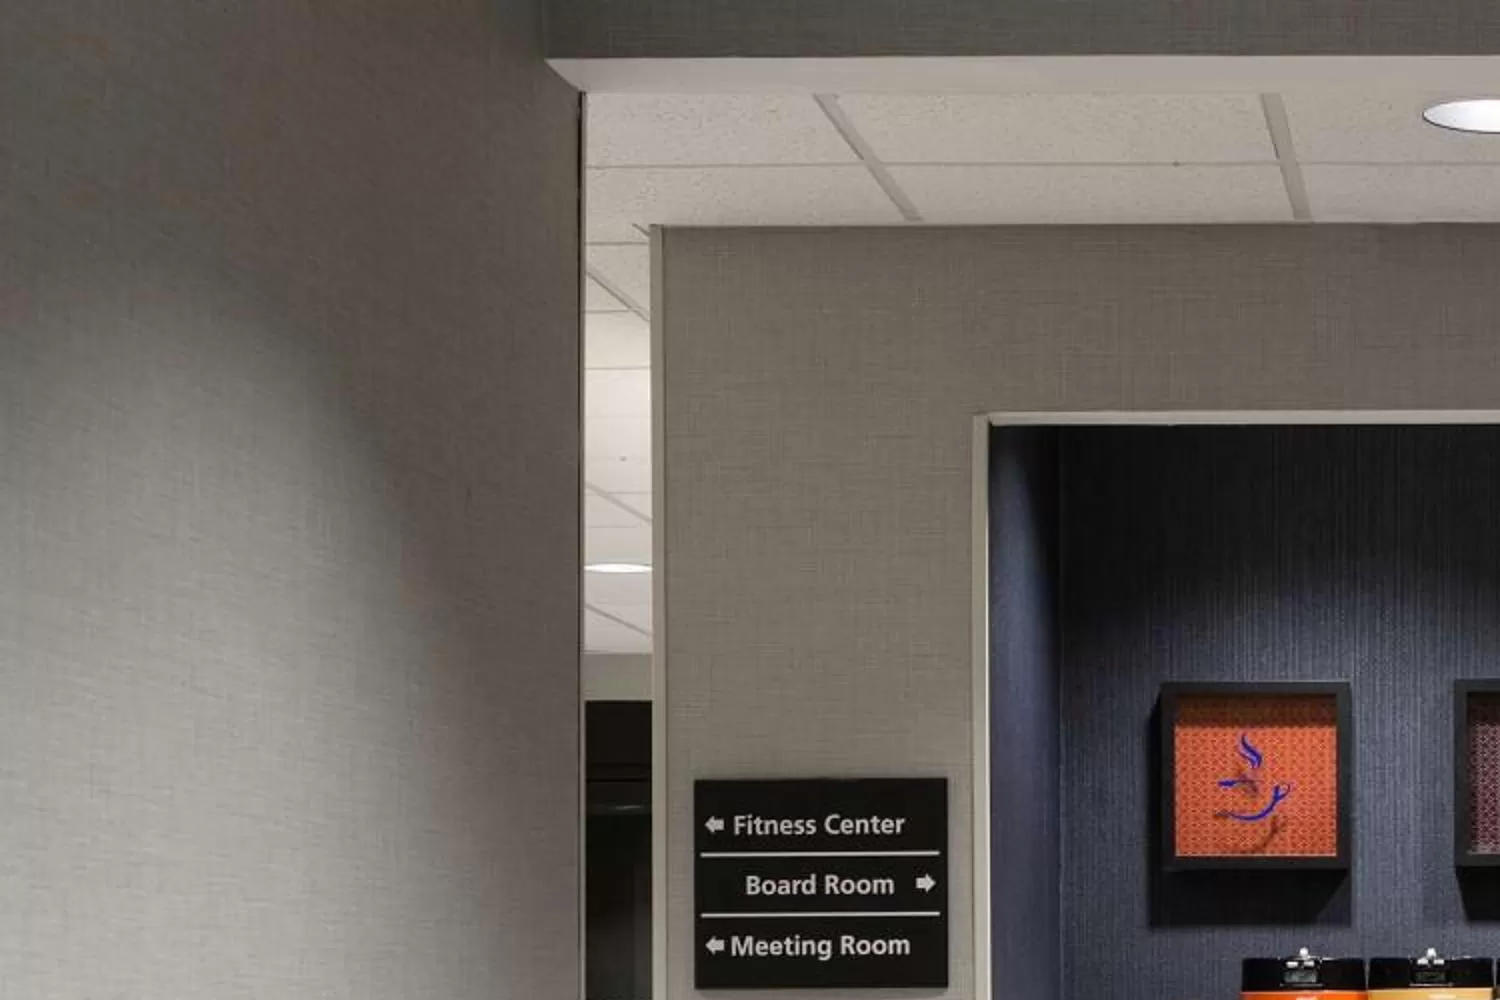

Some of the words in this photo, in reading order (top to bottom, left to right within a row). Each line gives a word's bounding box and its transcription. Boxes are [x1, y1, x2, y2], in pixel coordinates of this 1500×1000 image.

[735, 815, 816, 835] Fitness
[825, 814, 905, 834] Center
[747, 874, 816, 895] Board
[825, 875, 894, 894] Room
[732, 935, 832, 960] Meeting
[841, 936, 910, 955] Room
